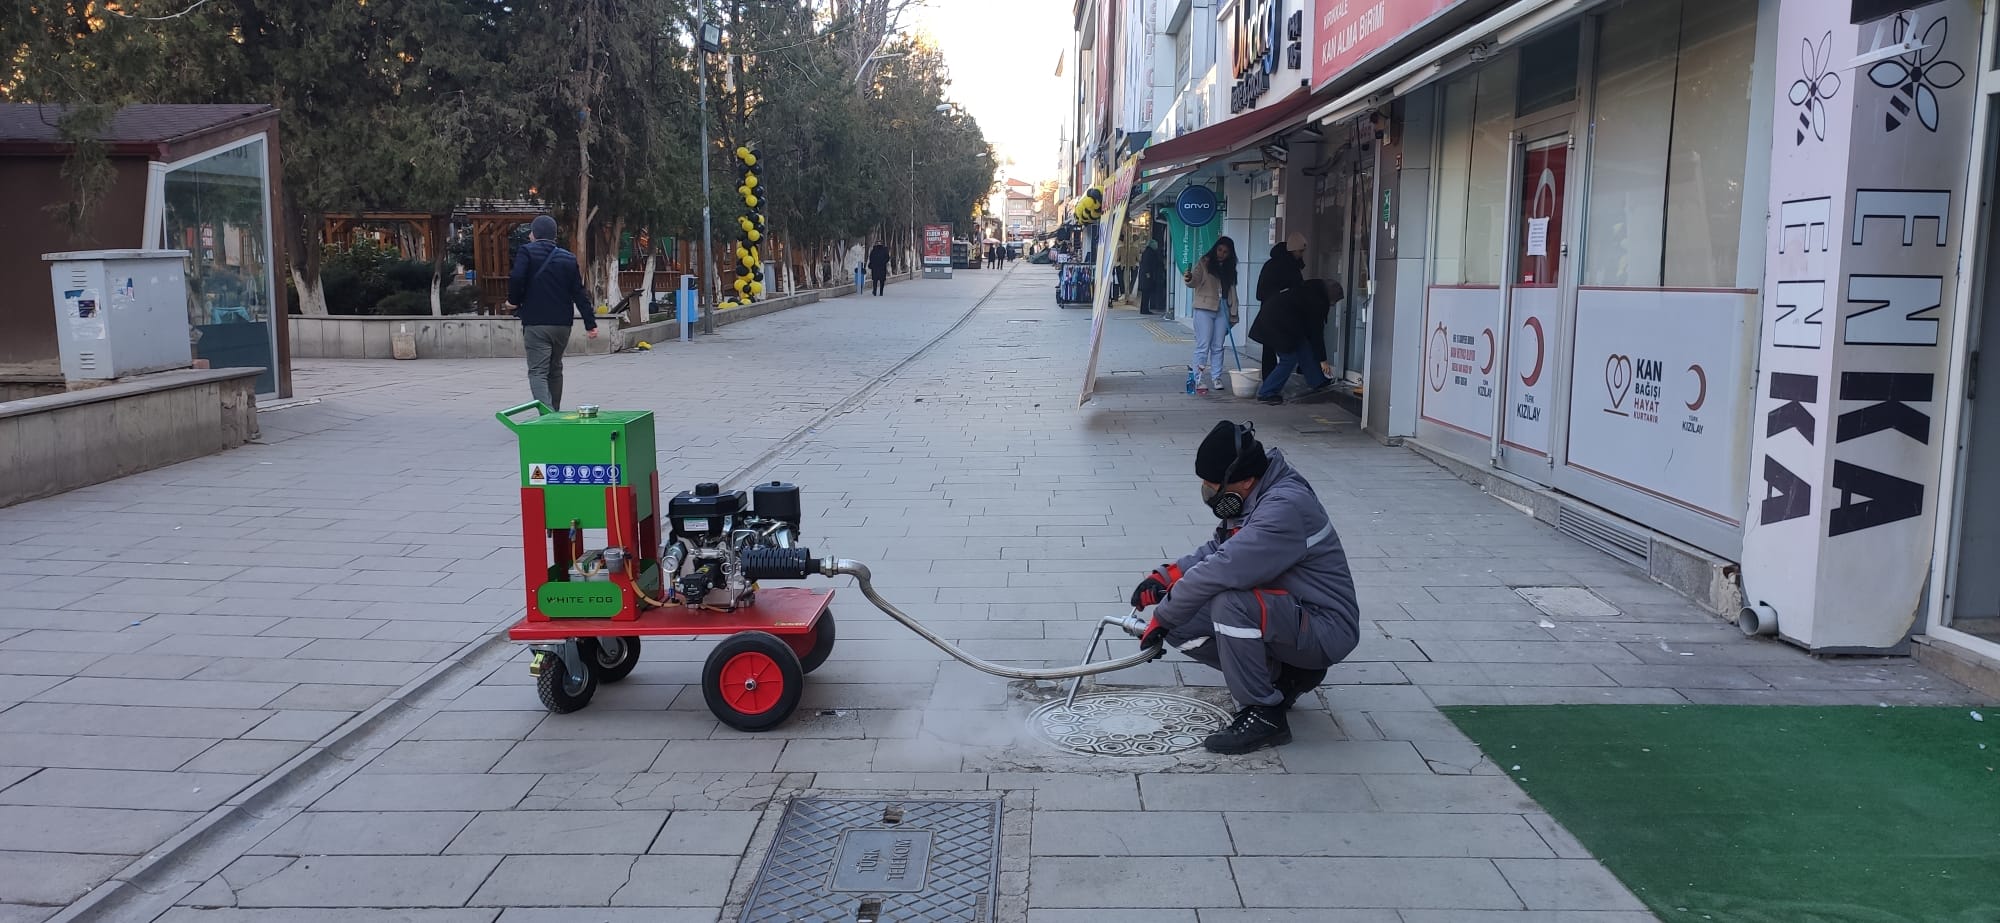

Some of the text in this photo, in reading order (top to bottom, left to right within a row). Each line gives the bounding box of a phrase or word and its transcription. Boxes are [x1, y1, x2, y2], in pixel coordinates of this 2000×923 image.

[1321, 37, 1337, 66] KAN
[1337, 21, 1358, 56] ALMA
[1636, 358, 1662, 382] KAN
[1761, 196, 1831, 526] ENKA
[1829, 188, 1951, 537] ENKA
[1635, 382, 1661, 399] BAĞIŞI
[1516, 403, 1541, 421] KIZILAY
[1634, 398, 1659, 413] HAYAT
[1633, 411, 1658, 424] KURTARIR
[1682, 422, 1703, 435] KIZILAY
[547, 596, 613, 604] WHITE FOG
[887, 839, 912, 881] TELEKOM
